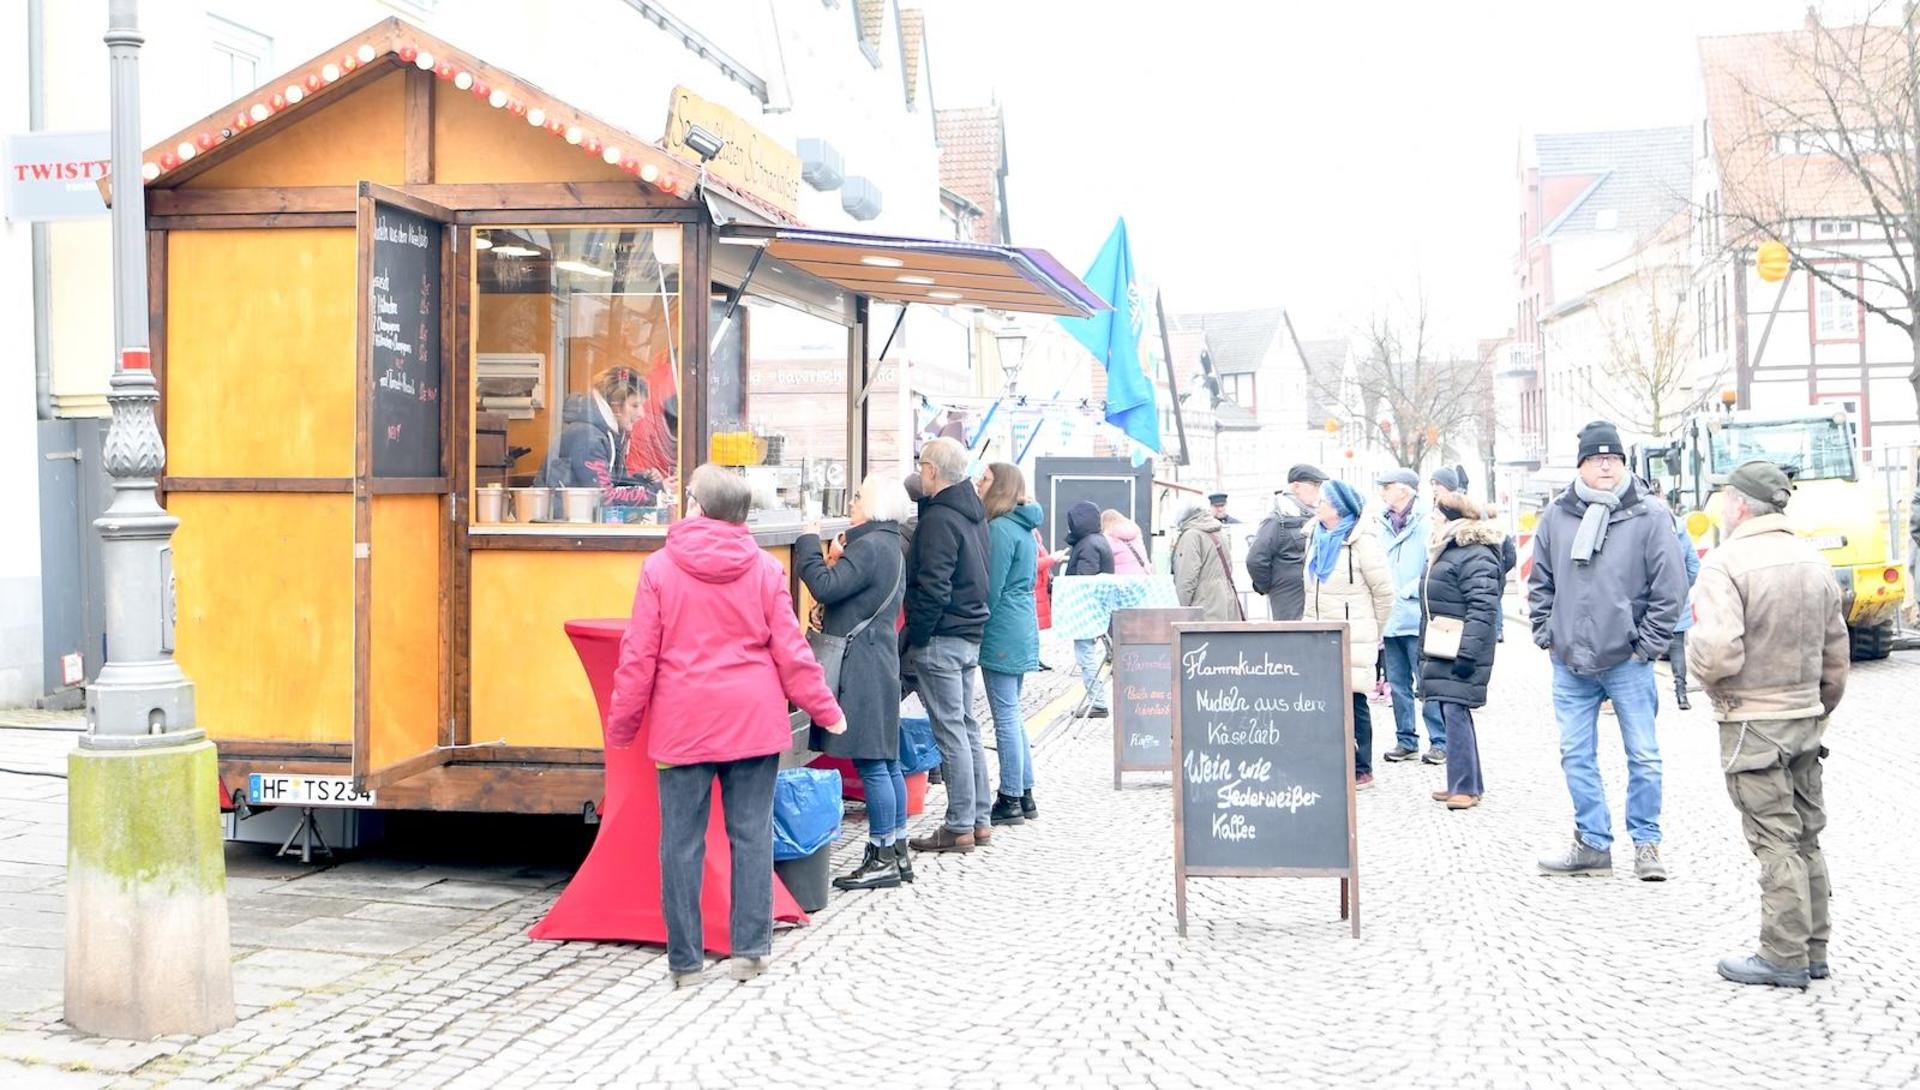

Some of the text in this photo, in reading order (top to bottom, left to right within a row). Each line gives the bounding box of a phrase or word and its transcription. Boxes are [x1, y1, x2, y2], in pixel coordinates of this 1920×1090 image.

[1182, 642, 1300, 679] Flammkuchen
[1196, 686, 1250, 712] Nudeln
[1254, 697, 1289, 712] aus
[1208, 718, 1281, 745] Käselaib
[1184, 750, 1272, 784] Wein wie
[263, 779, 289, 799] HF
[304, 780, 330, 801] TS
[1217, 779, 1321, 814] Federweißer
[1212, 813, 1256, 842] Kaffee
